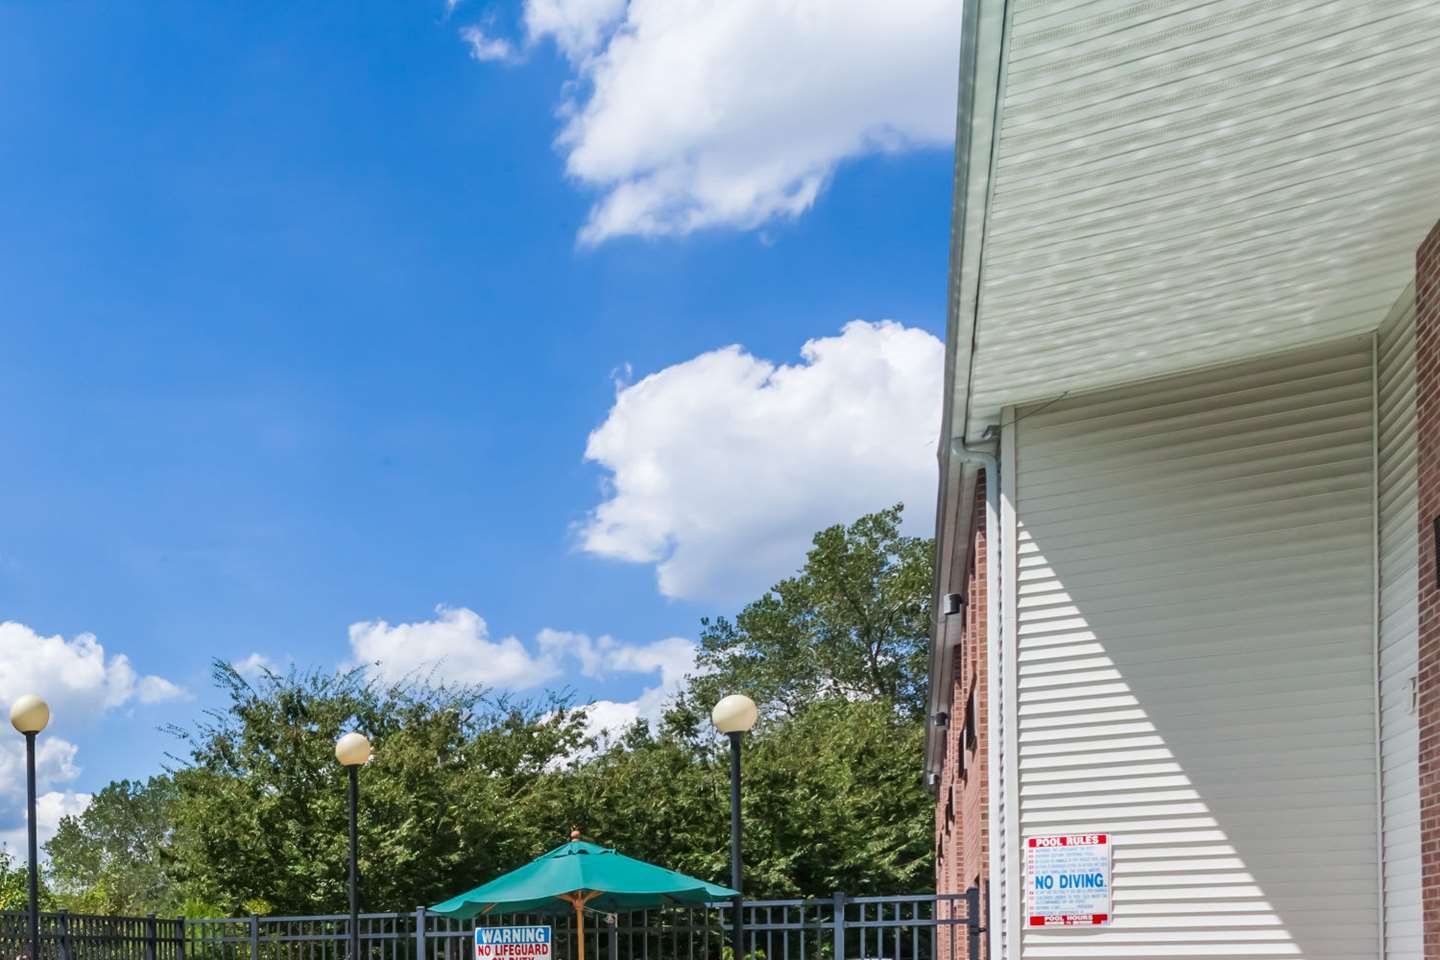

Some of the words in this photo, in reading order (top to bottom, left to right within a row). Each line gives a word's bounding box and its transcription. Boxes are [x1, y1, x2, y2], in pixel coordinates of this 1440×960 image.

[1036, 837, 1063, 847] POOL
[1066, 835, 1099, 845] RULES
[1035, 875, 1054, 890] NO
[1059, 872, 1107, 889] DIVING.
[482, 928, 545, 944] WARNING
[478, 945, 491, 957] NO
[495, 943, 548, 956] LIFEGUARD
